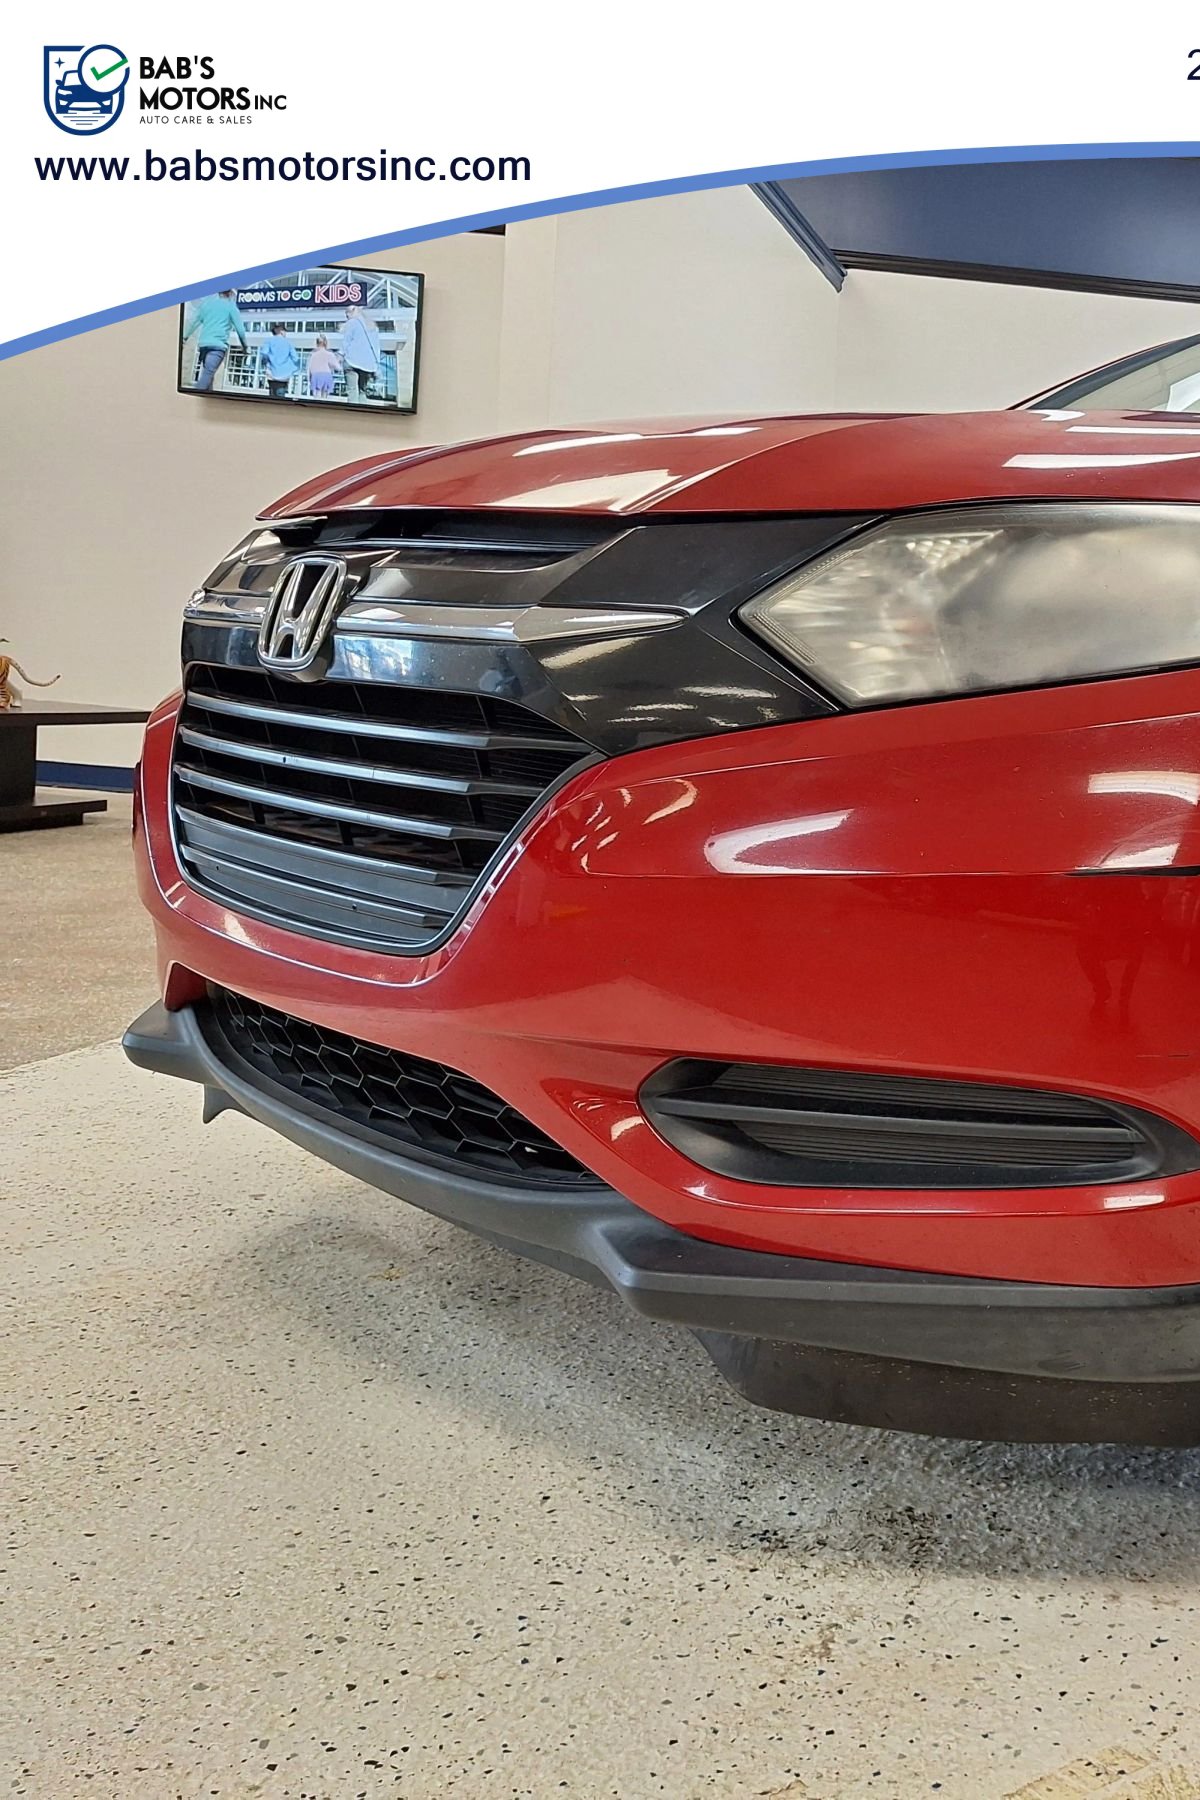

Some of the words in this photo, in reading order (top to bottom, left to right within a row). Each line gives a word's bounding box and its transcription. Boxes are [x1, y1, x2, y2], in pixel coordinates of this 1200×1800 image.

[238, 291, 275, 303] ROOMS
[276, 290, 291, 302] TO
[292, 289, 311, 301] GO
[315, 284, 361, 303] KIDS
